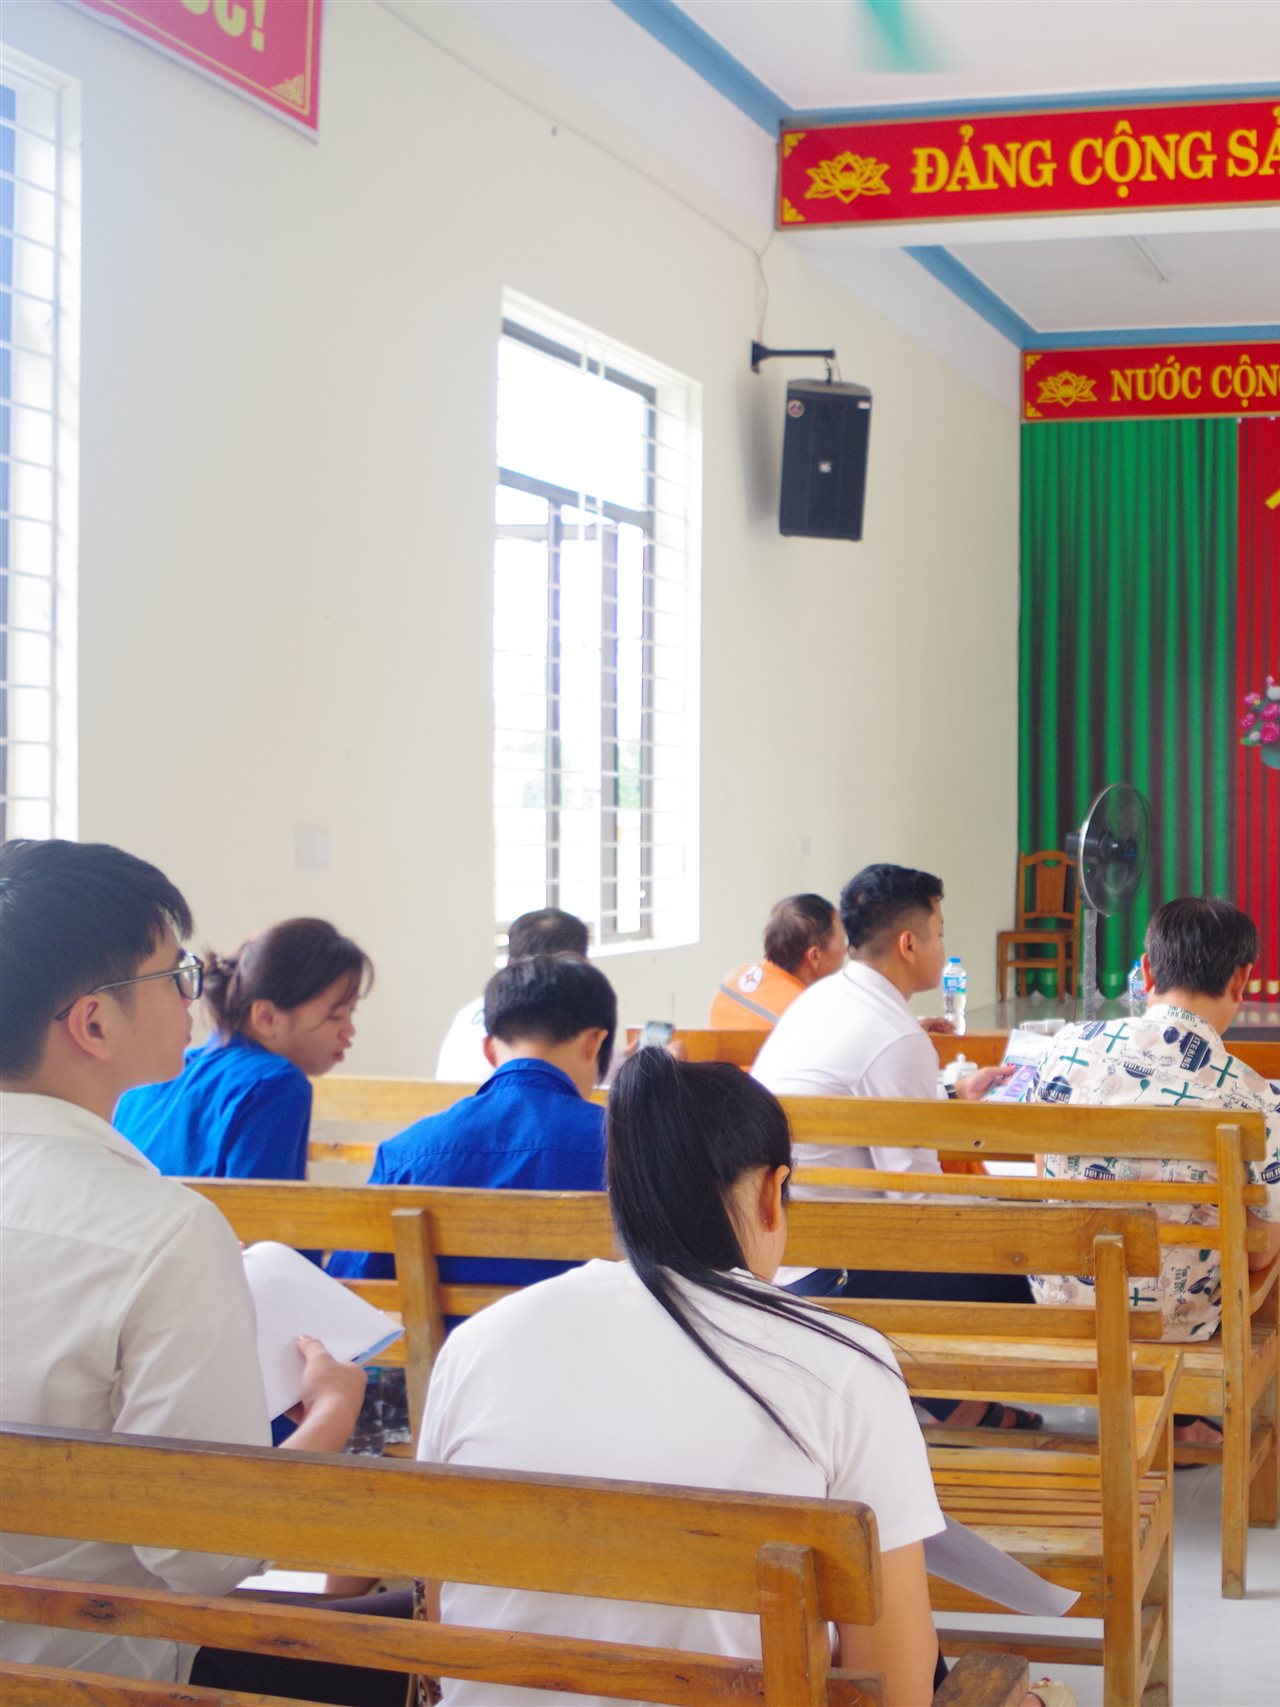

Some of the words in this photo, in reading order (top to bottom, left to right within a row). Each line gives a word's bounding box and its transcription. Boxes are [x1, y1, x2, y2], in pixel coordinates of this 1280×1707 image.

[911, 124, 1057, 194] ĐẢNG
[1069, 119, 1218, 198] CỘNG
[1110, 355, 1202, 402] NƯỚC
